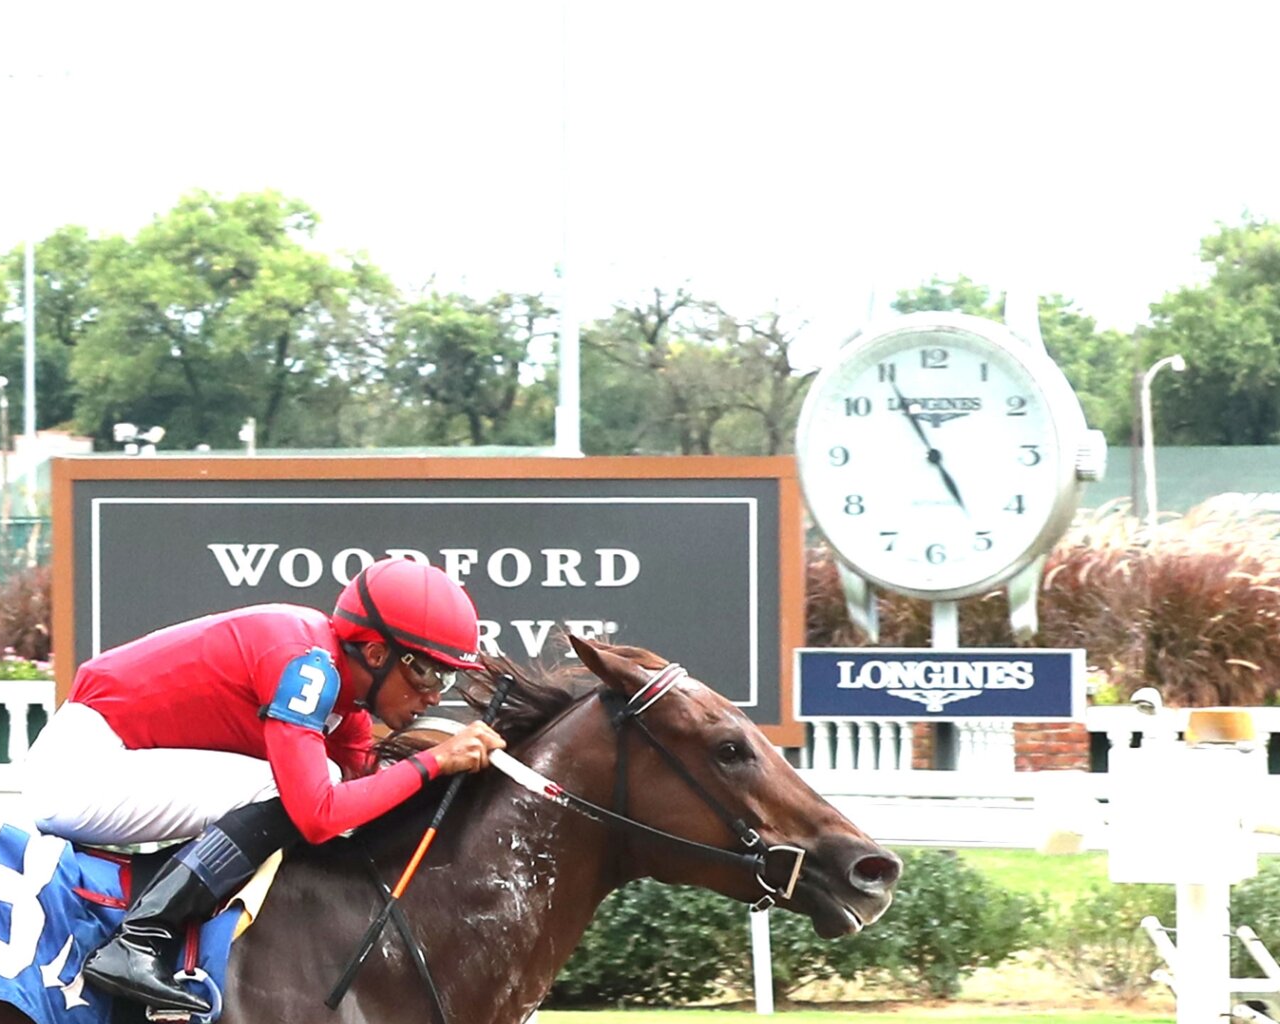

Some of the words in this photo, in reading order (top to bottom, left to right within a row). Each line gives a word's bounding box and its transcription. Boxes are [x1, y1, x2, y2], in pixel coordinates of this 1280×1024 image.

[920, 350, 949, 369] 12
[878, 363, 896, 382] 11
[979, 363, 989, 381] 1
[844, 397, 872, 417] 10
[1006, 396, 1027, 416] 2
[829, 446, 850, 467] 9
[1020, 445, 1041, 466] 3
[844, 495, 865, 516] 8
[1003, 495, 1026, 515] 4
[879, 531, 899, 552] 7
[973, 531, 993, 552] 5
[925, 544, 946, 565] 6
[837, 661, 1034, 690] LONGINES
[288, 664, 326, 715] 3
